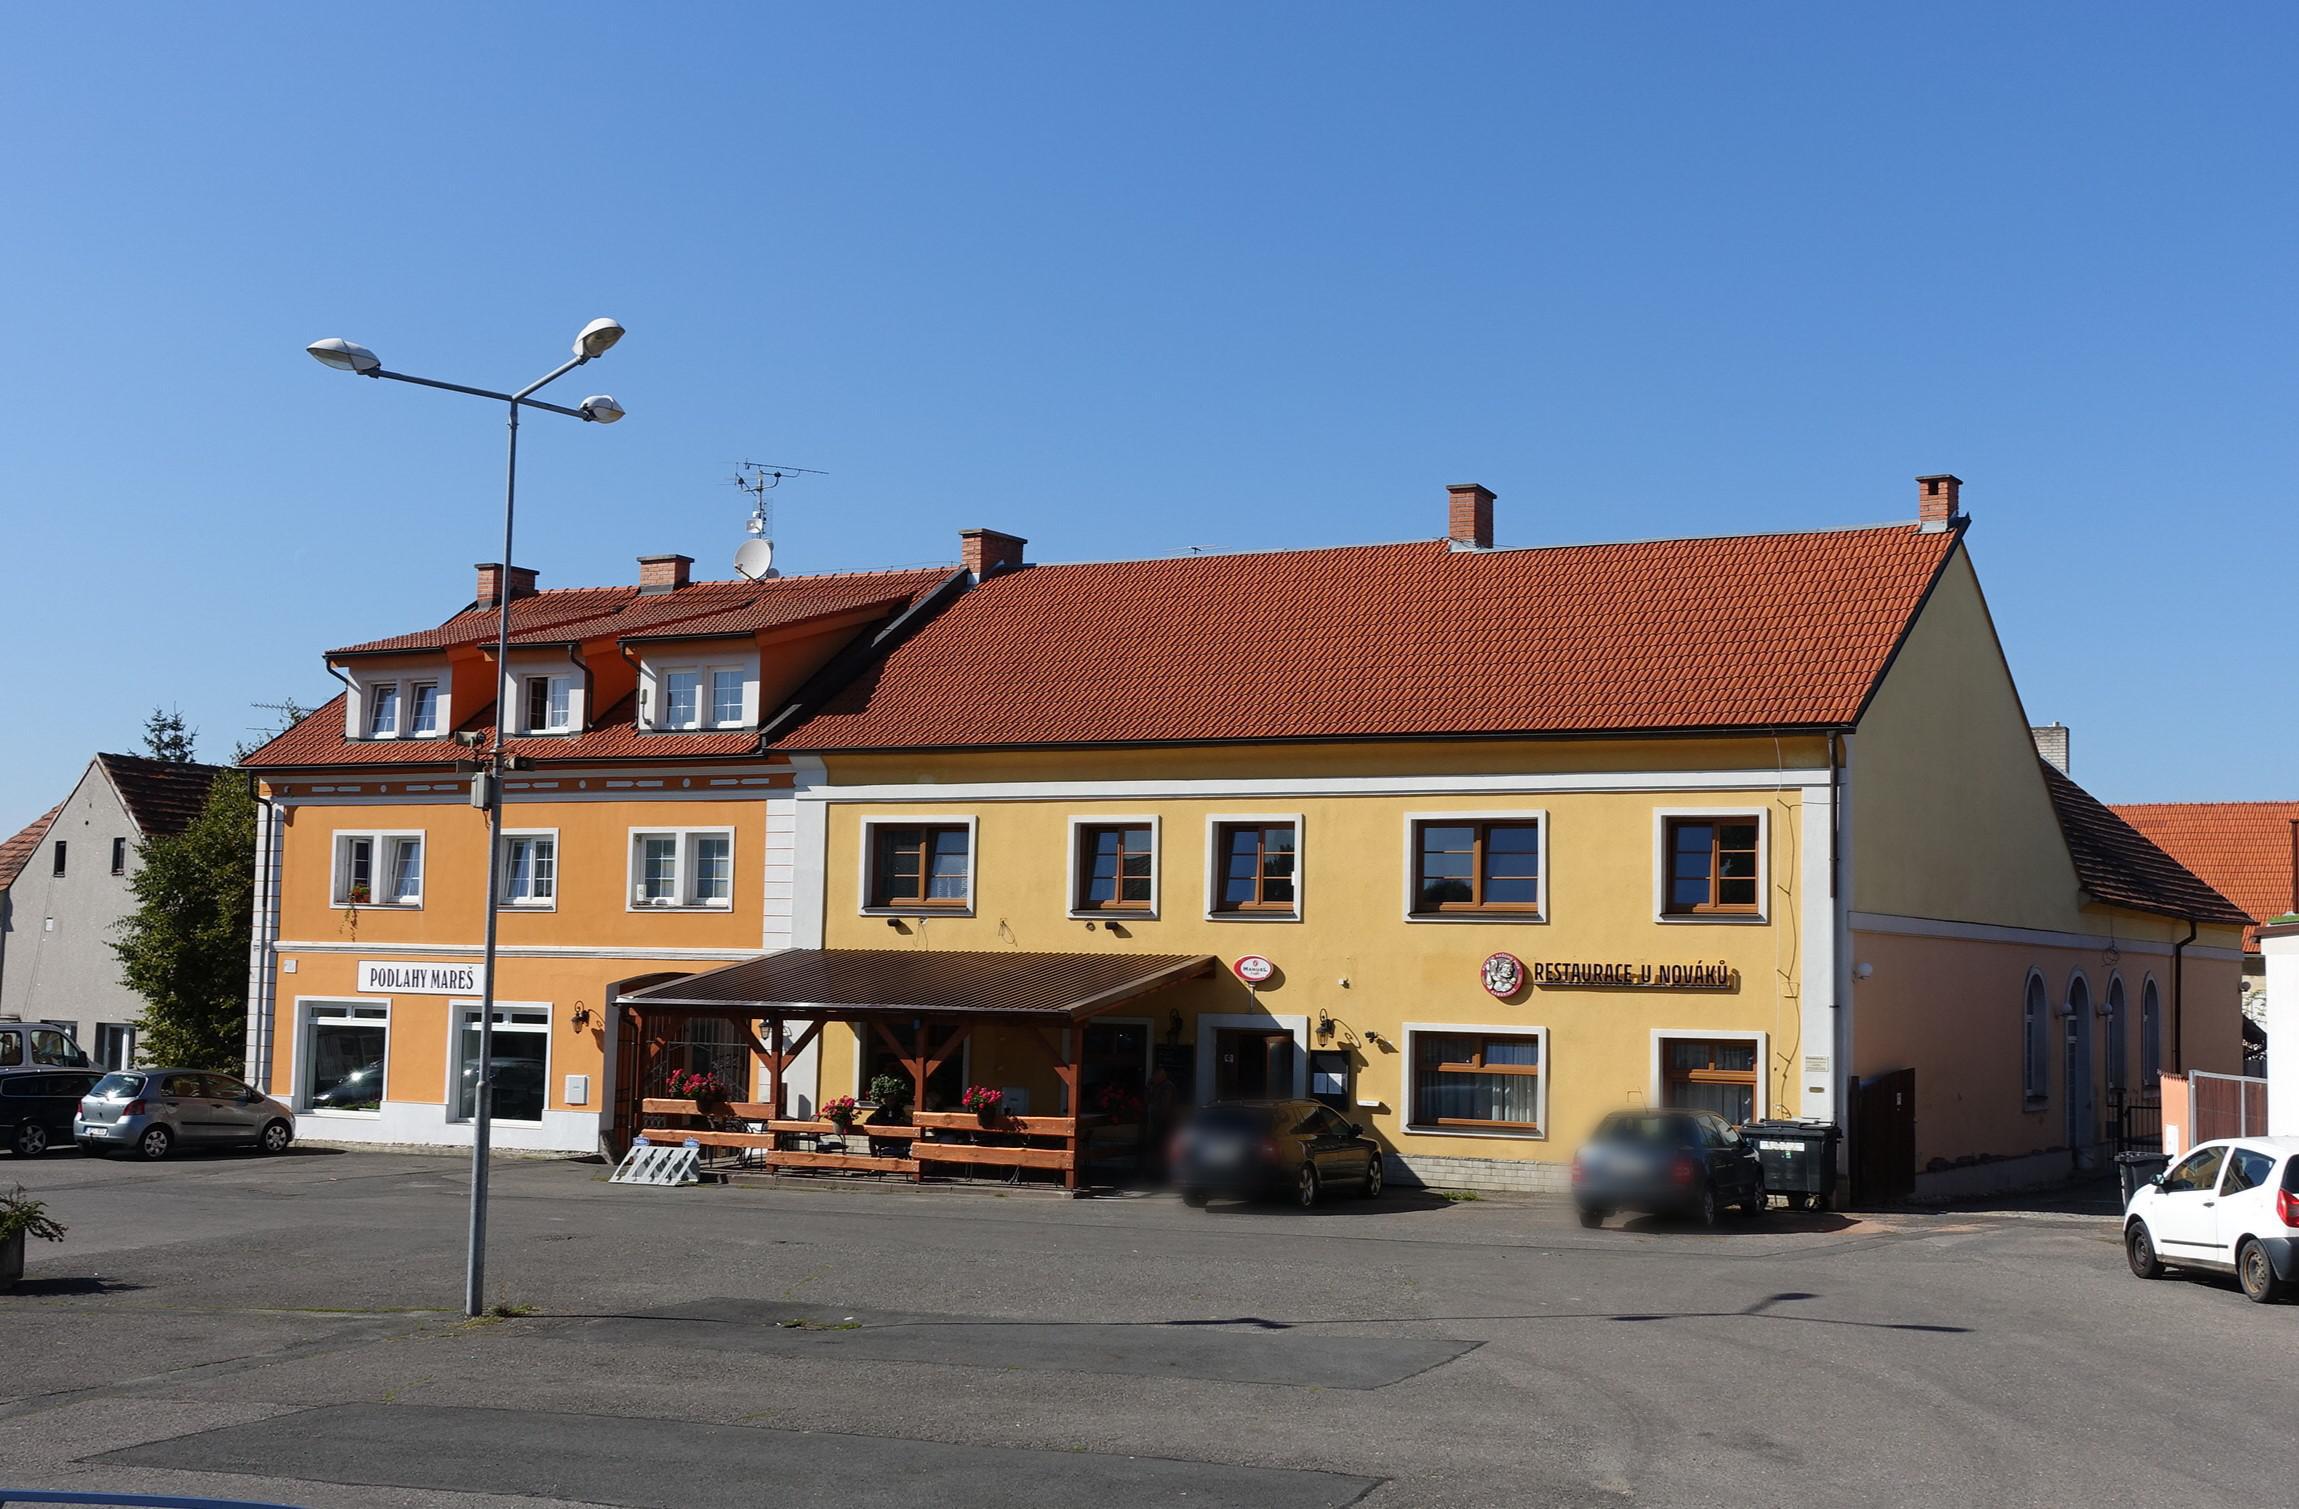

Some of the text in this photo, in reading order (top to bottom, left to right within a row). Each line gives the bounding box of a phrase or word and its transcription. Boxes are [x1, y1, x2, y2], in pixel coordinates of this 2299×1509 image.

[370, 965, 474, 990] PODLAHY MAREŠ
[1534, 959, 1728, 985] RESTAURACE U NOVÁKŮ
